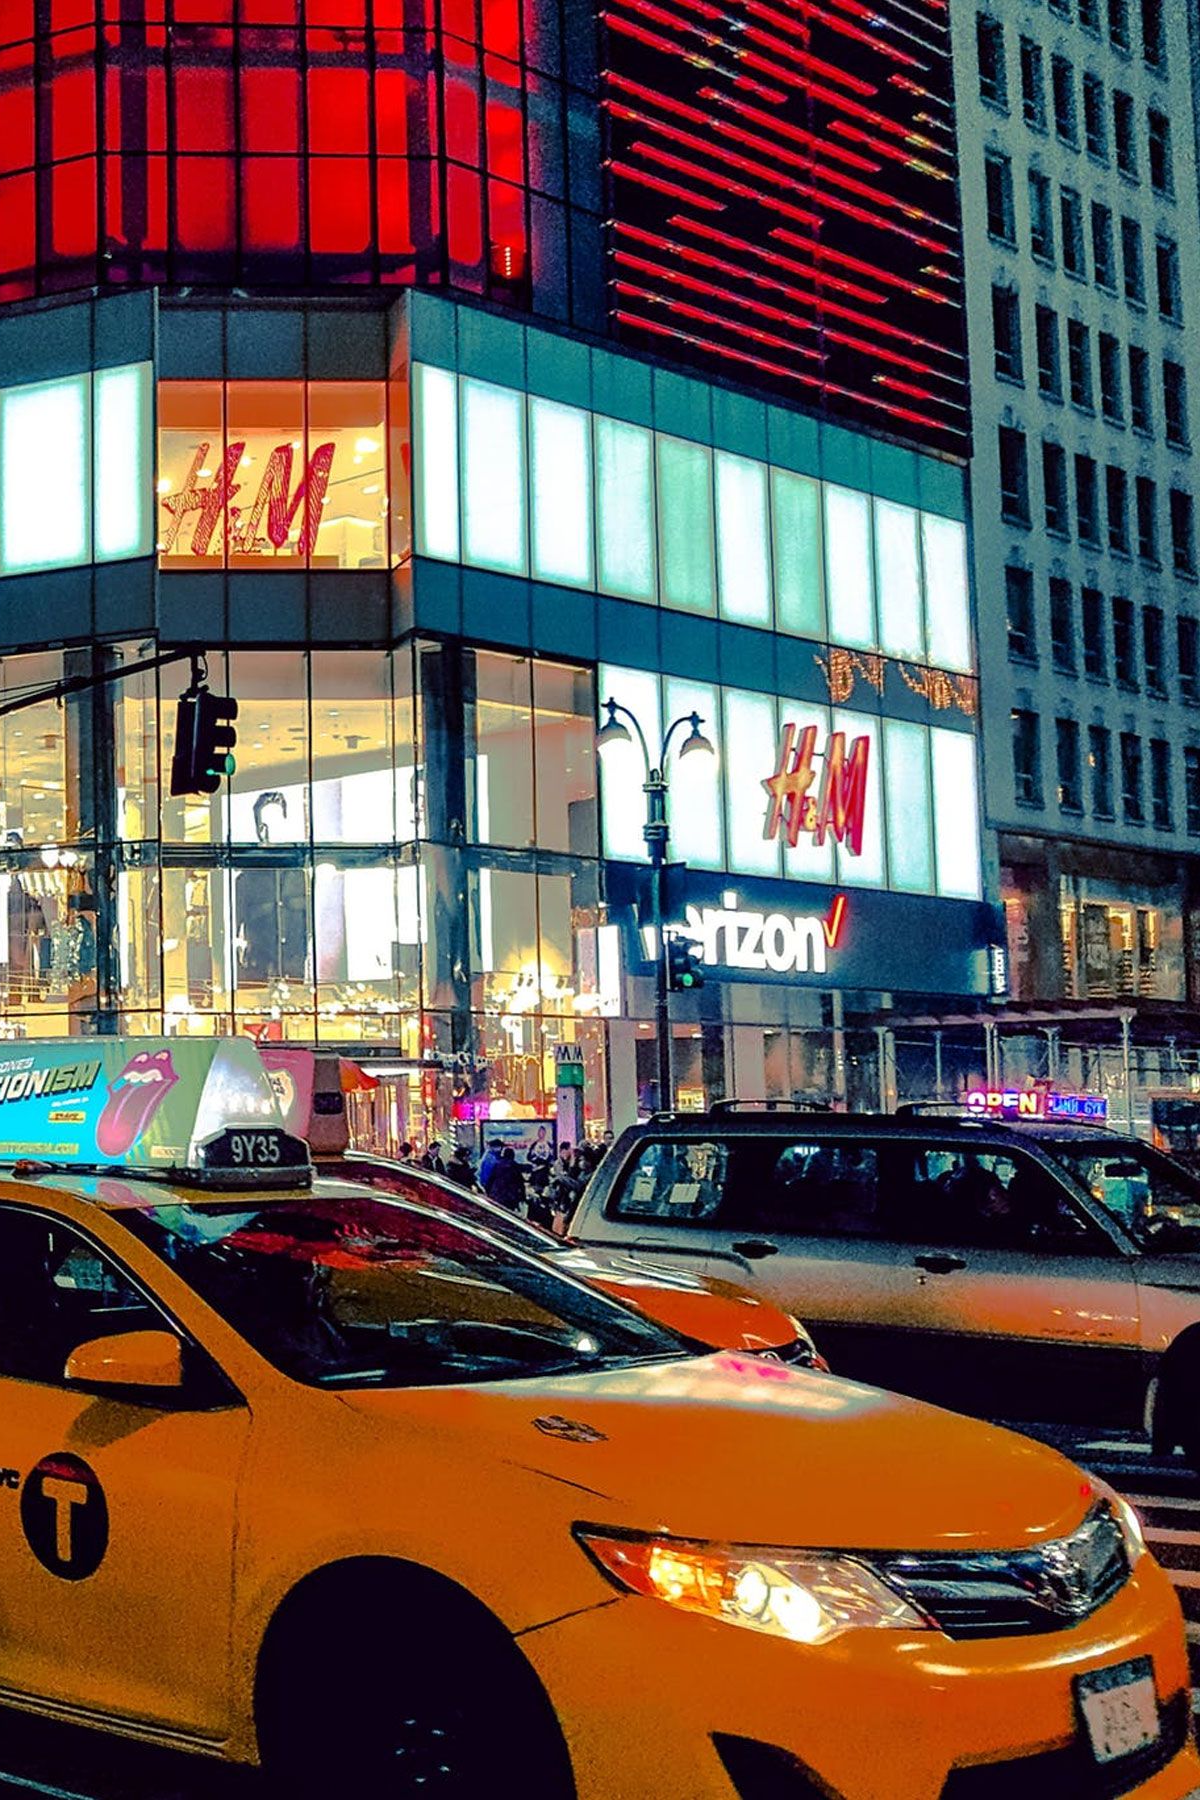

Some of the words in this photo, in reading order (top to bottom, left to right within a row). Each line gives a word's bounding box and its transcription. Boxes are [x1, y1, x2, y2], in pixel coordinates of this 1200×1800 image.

[761, 722, 870, 857] H&M
[664, 890, 827, 974] rizon
[967, 1091, 1037, 1114] OPEN
[231, 1134, 280, 1163] 9Y35
[41, 1475, 88, 1562] T
